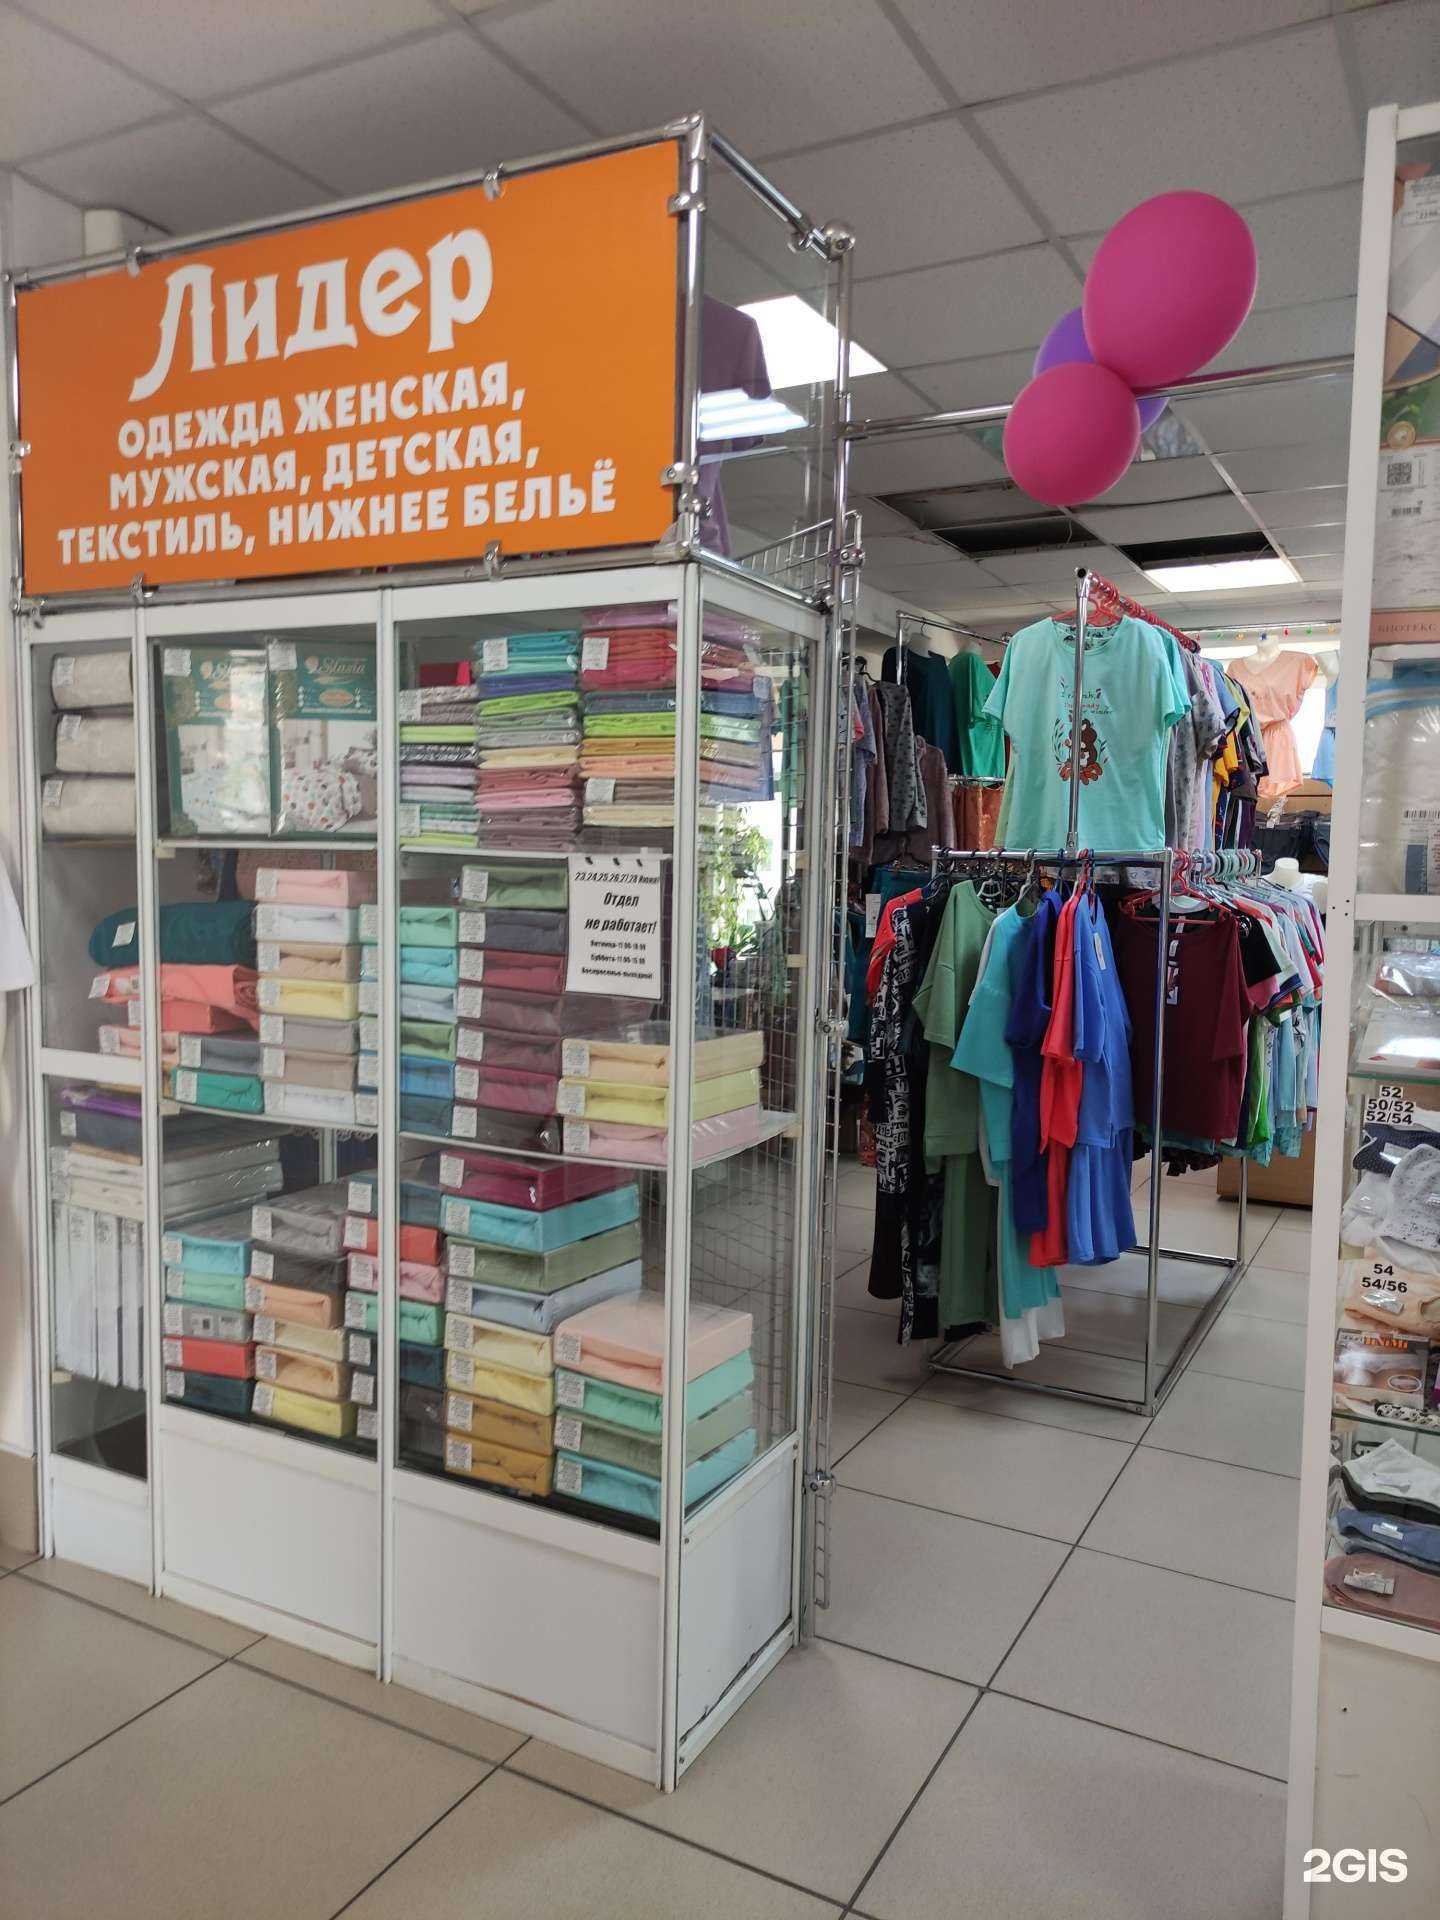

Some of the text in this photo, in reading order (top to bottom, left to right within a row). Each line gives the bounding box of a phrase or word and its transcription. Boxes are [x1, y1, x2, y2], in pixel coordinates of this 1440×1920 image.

[129, 228, 492, 401] Лидер
[119, 362, 524, 459] ОДЕЖДА ЖЕНСКАЯ,
[110, 420, 538, 509] МУЖСКАЯ, ДЕТСКАЯ,
[58, 459, 615, 564] ТЕКСТИЛЬ, НИЖНЕЕ БЕЛЬЁ
[603, 892, 639, 907] Отдел
[584, 918, 657, 935] не работает!
[1381, 1086, 1402, 1098] 52
[1368, 1098, 1414, 1113] 50/52
[1366, 1110, 1413, 1125] 52/54
[1373, 1263, 1394, 1276] 54
[1361, 1277, 1408, 1293] 54/56
